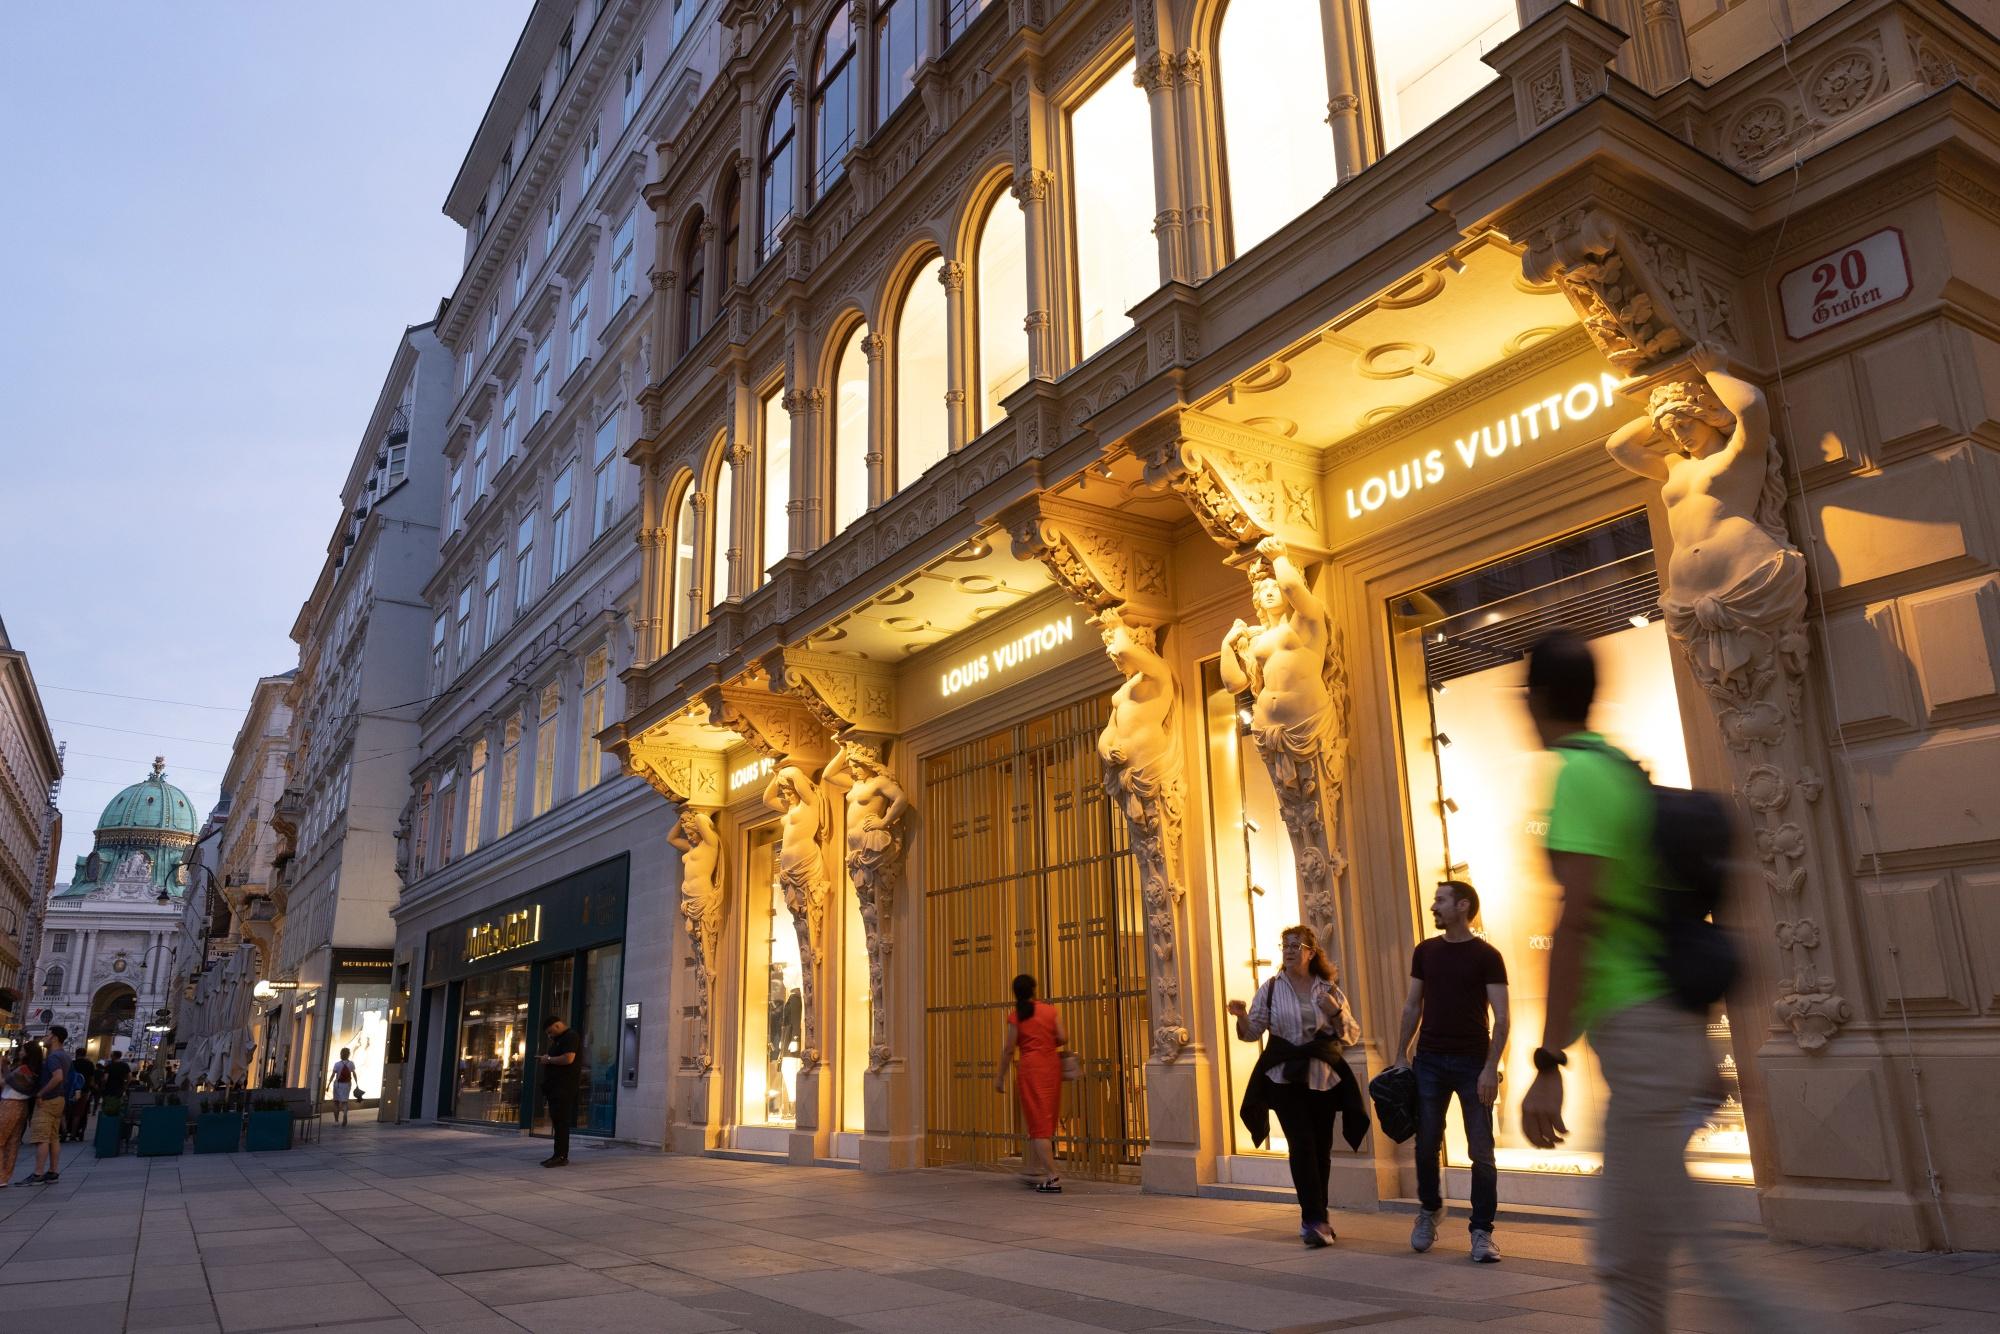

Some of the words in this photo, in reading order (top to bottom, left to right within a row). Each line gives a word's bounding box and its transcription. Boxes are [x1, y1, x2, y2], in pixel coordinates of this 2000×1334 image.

[1811, 249, 1867, 307] 20
[1812, 287, 1882, 325] Graben
[1346, 449, 1445, 519] LOUIS
[942, 655, 989, 697] LOUIS
[993, 615, 1073, 672] VUITTON
[730, 761, 759, 791] LOUIS
